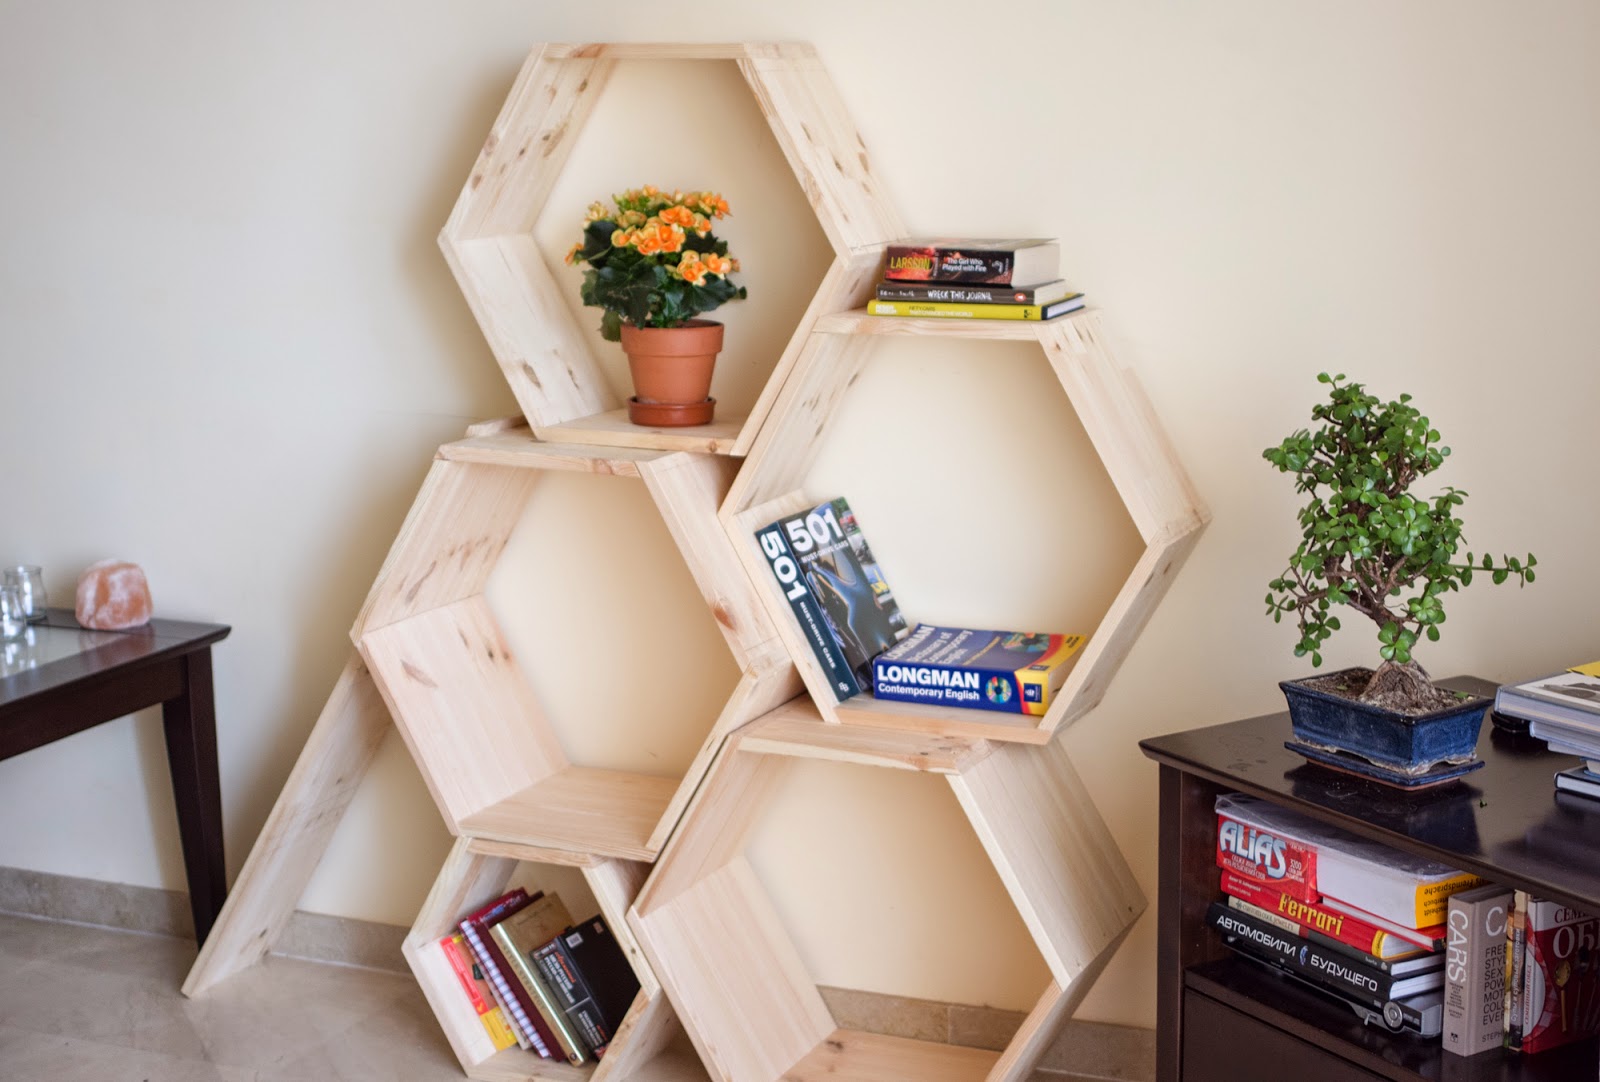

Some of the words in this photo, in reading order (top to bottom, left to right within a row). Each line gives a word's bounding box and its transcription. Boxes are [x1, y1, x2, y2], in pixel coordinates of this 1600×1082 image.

[891, 257, 930, 270] LARSSON
[942, 263, 962, 271] Played
[927, 290, 949, 299] WRECK
[950, 290, 965, 300] THIS
[966, 291, 992, 300] JOURNAL
[785, 508, 844, 552] 501
[801, 544, 834, 564] MUST-DRIVE
[833, 539, 849, 552] CARS
[760, 530, 807, 601] 501
[800, 601, 825, 648] MUST-DRIVE
[822, 646, 836, 669] CARS
[881, 625, 936, 660] LONGMAN
[877, 665, 980, 689] LONGMAN
[878, 683, 943, 699] Contemporary
[945, 687, 980, 701] English
[1424, 878, 1474, 895] Fremdsprache
[1278, 892, 1345, 937] Ferrari
[1485, 906, 1508, 937] C
[1217, 915, 1296, 957] АВТОМОБИЛИ
[1310, 955, 1378, 992] БУДУЩЕГО
[1447, 910, 1468, 982] CARS
[1484, 967, 1504, 981] SEX
[1511, 964, 1520, 995] суповые
[1510, 1001, 1518, 1022] Супы
